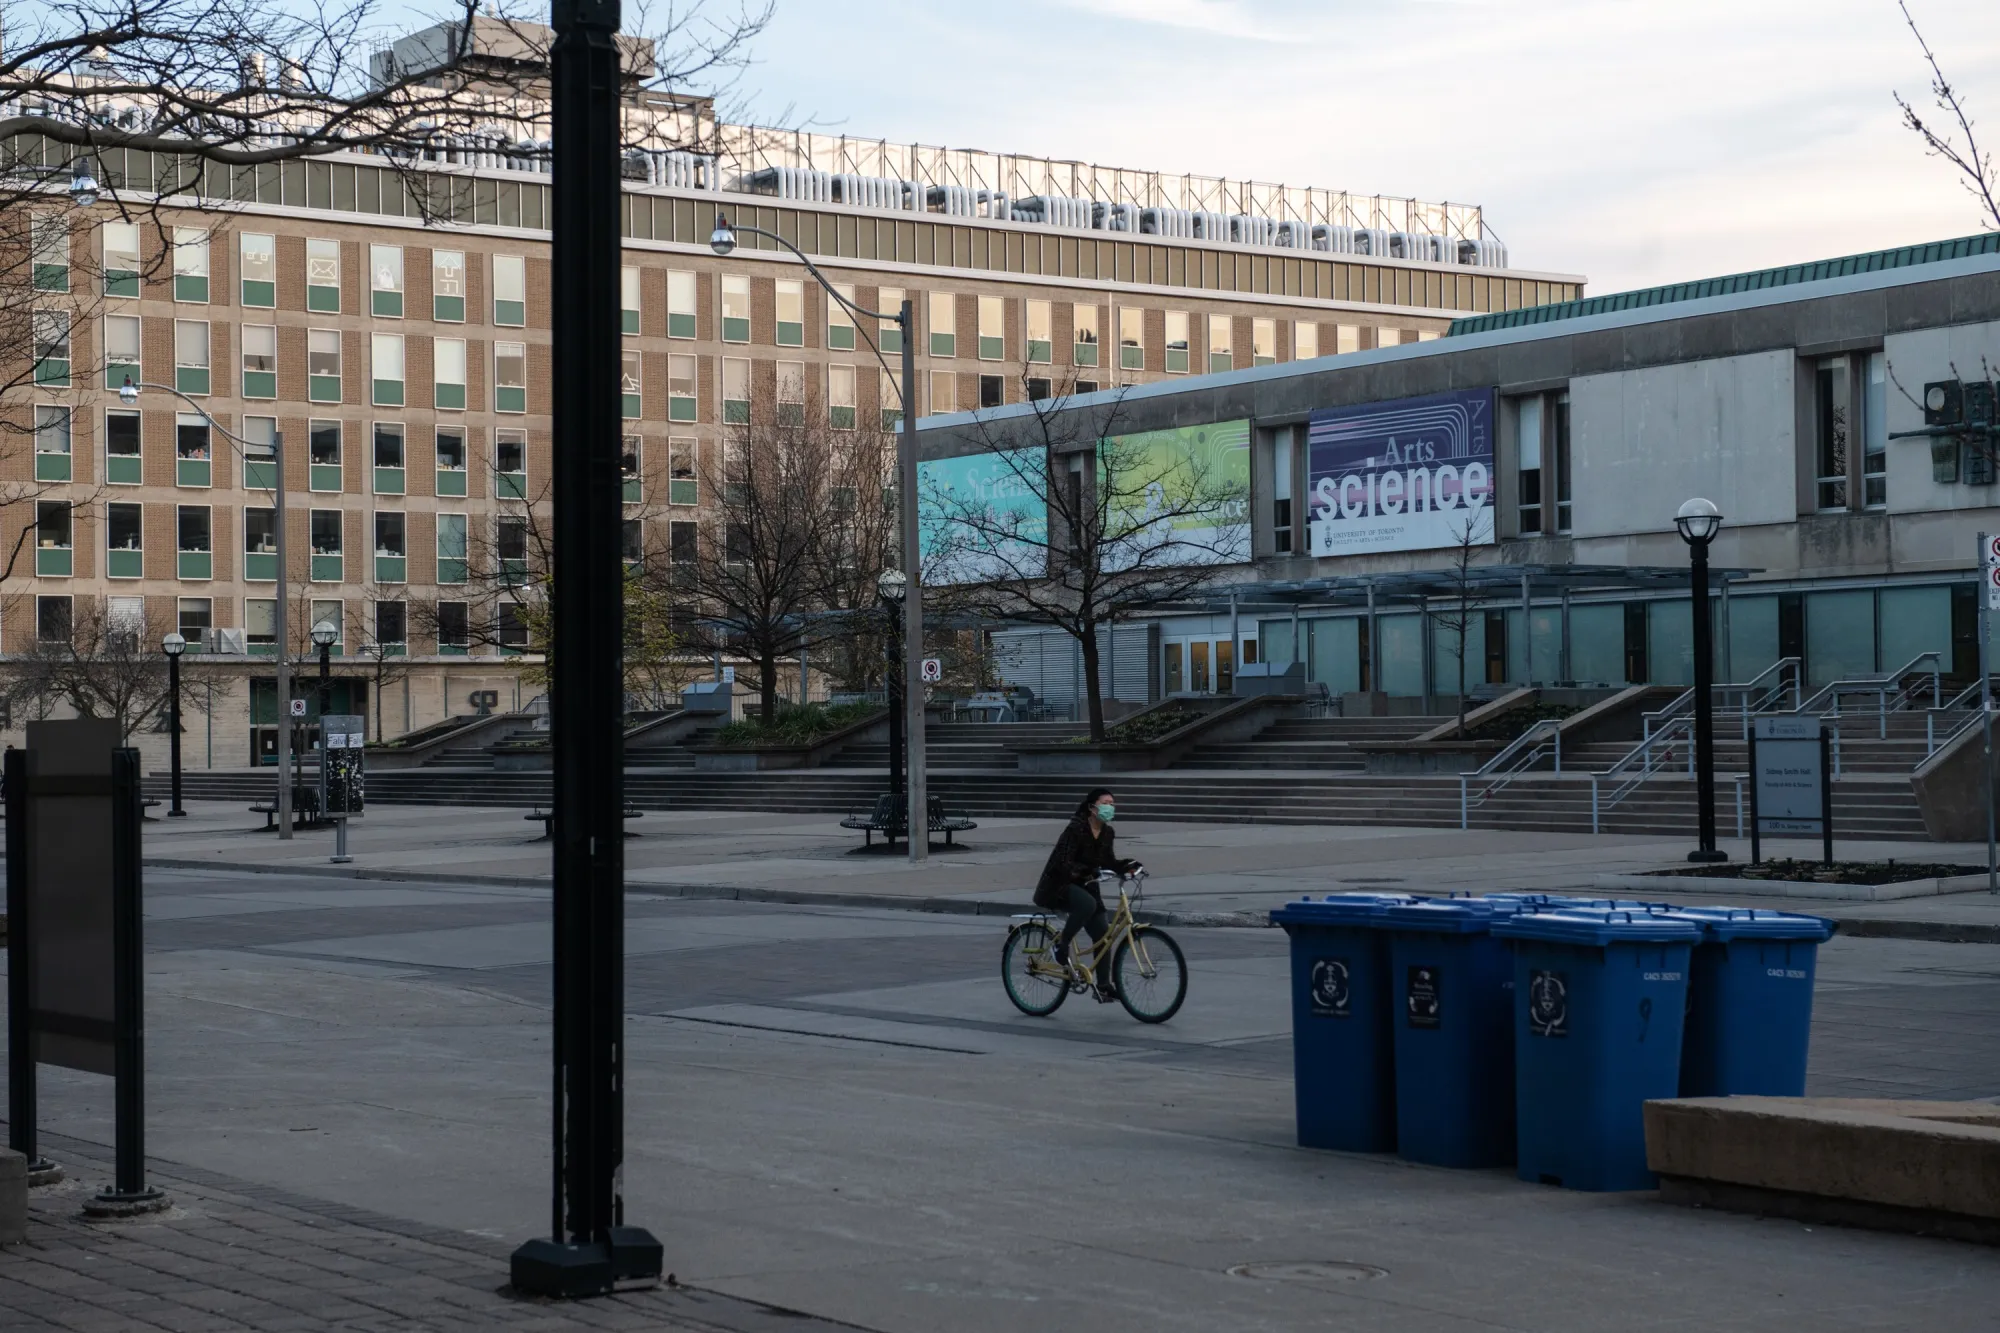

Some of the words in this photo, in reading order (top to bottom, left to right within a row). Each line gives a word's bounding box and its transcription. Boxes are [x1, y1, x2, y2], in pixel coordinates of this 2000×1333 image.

[1467, 399, 1487, 455] Arts
[1383, 436, 1435, 466] Arts
[1315, 456, 1488, 522] science
[1378, 526, 1404, 535] TORONTO
